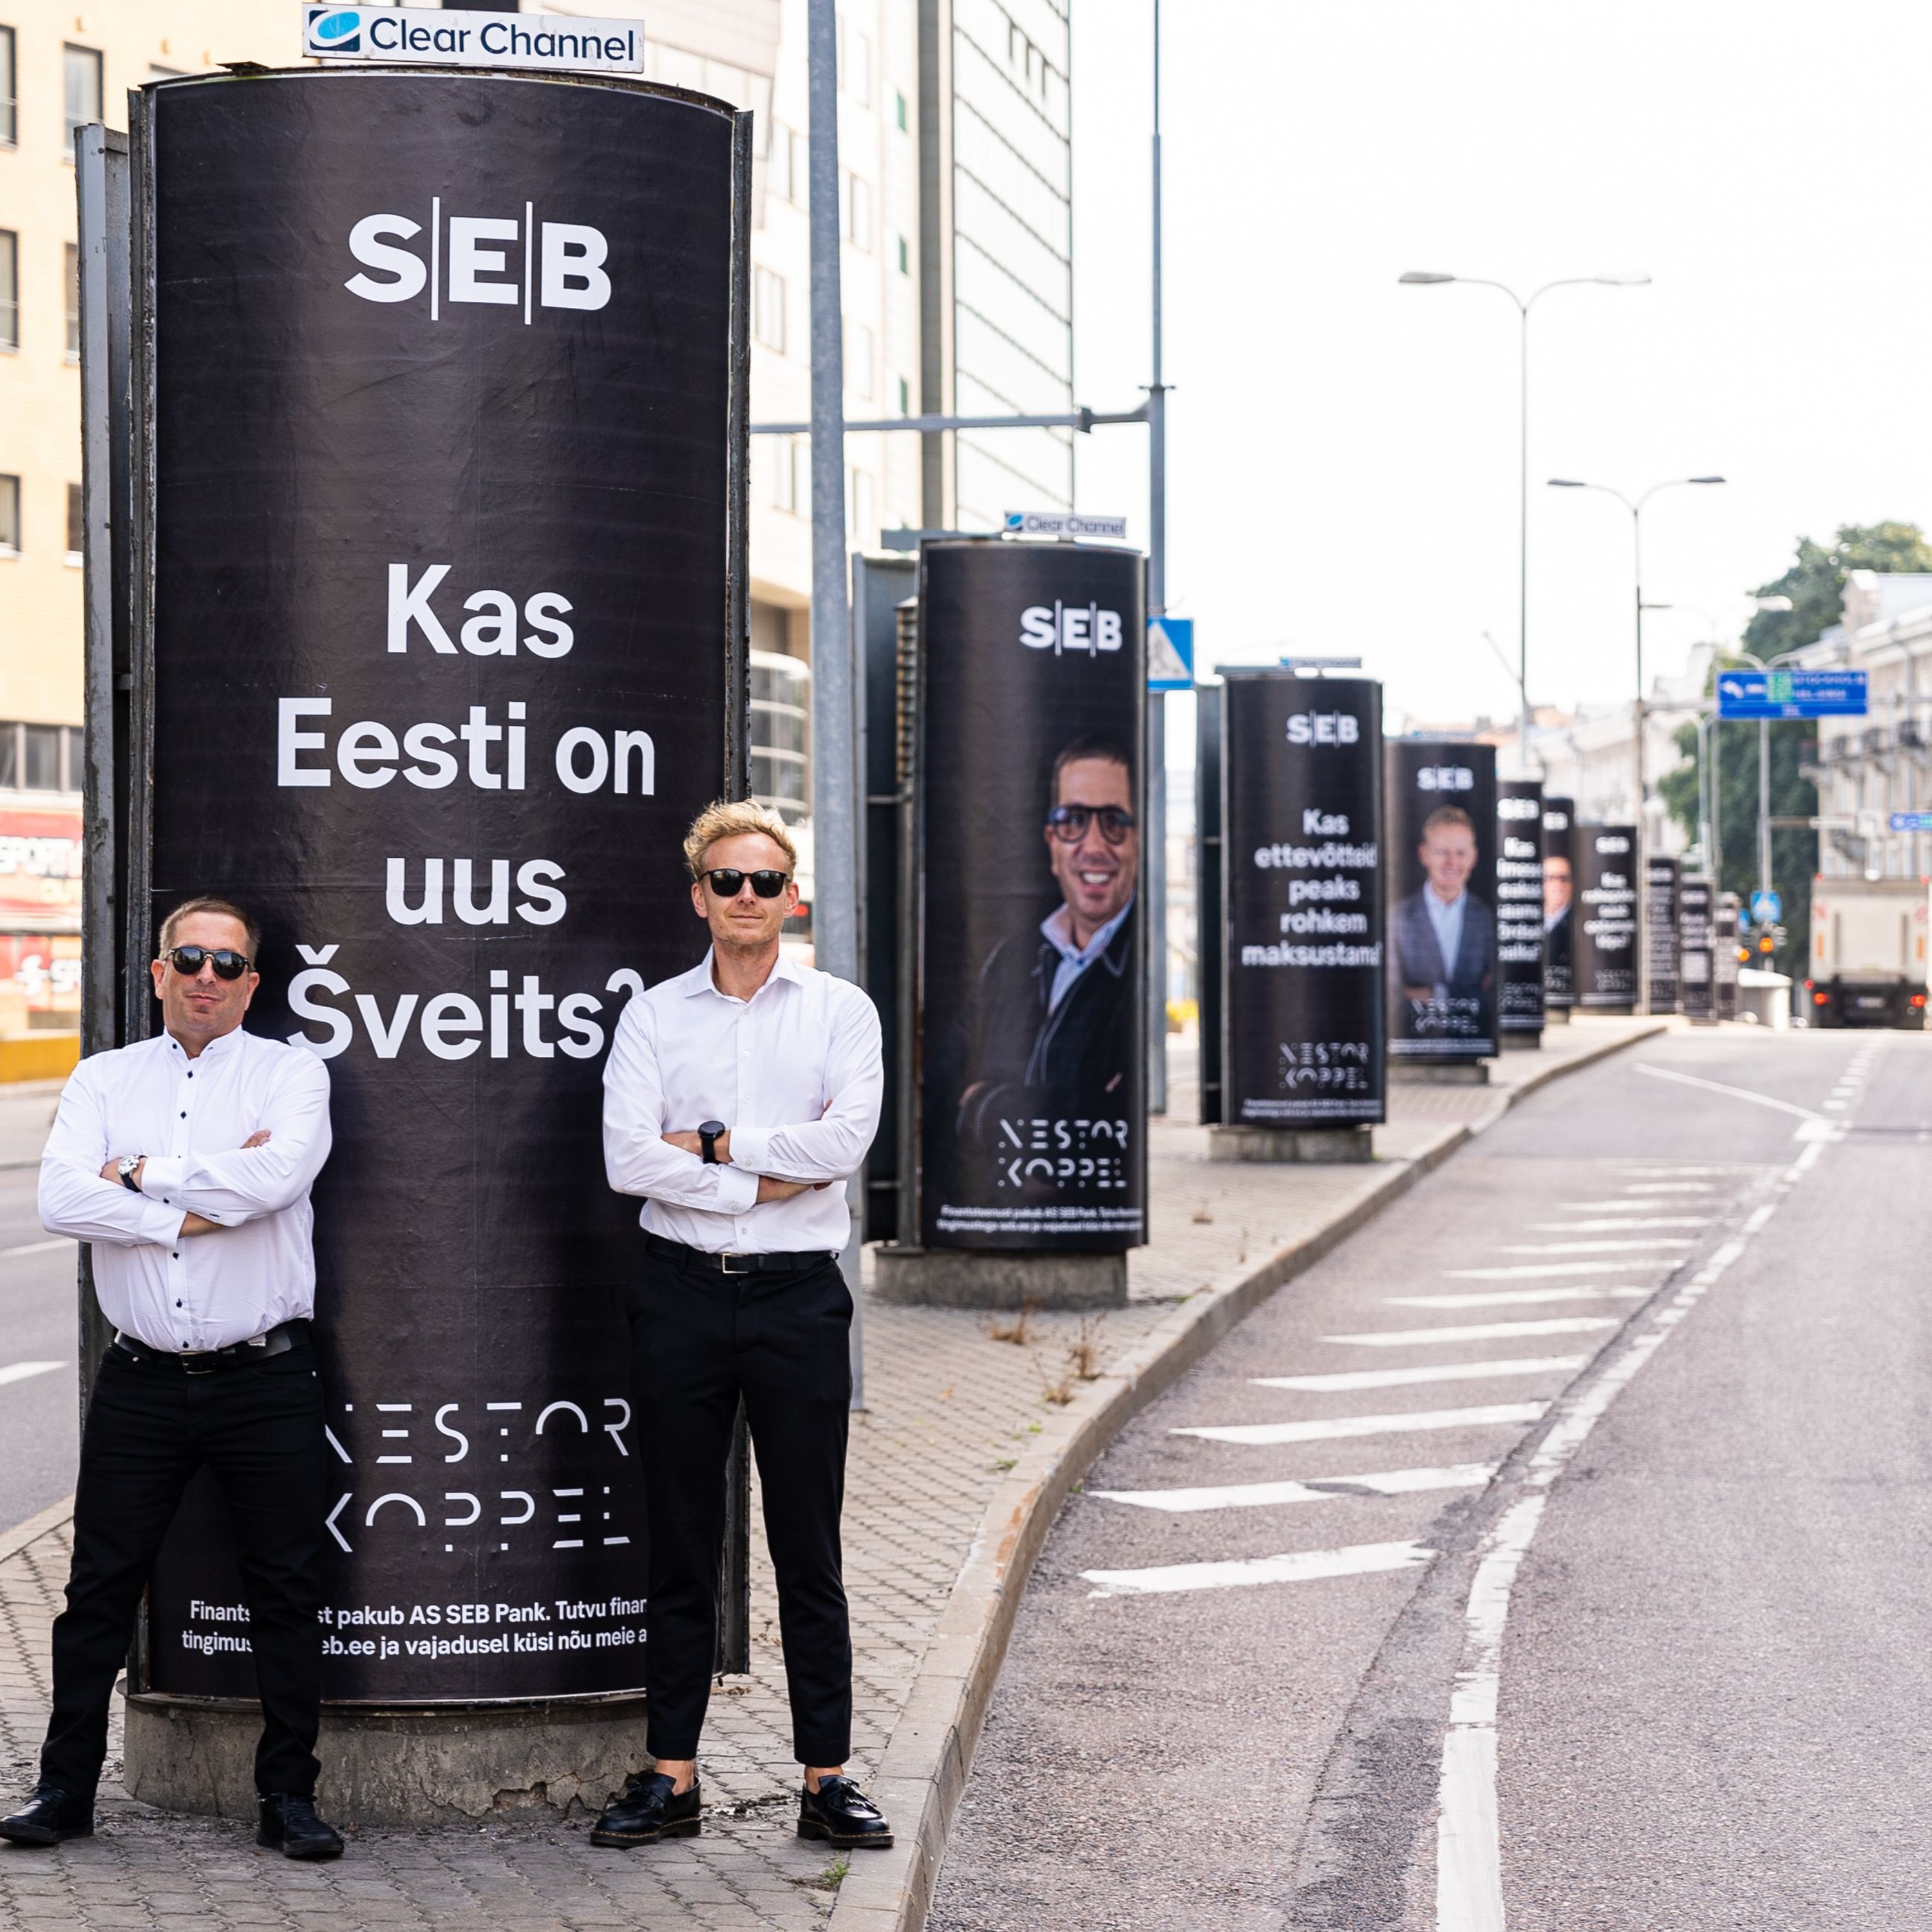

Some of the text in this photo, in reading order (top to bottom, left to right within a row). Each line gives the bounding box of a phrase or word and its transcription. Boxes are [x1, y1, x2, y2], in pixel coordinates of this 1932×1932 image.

[368, 17, 634, 62] Clear Channel
[387, 564, 574, 659] Kas
[278, 697, 656, 795] Eesti on
[1303, 808, 1350, 835] Kas
[386, 857, 567, 925] uus
[1289, 875, 1361, 906] peaks
[338, 1605, 405, 1629] pakub
[408, 1605, 442, 1625] AS
[446, 1604, 490, 1625] SEB
[495, 1602, 551, 1623] Pank.
[554, 1600, 606, 1620] Tutvu
[322, 1635, 376, 1655] eb.ee
[379, 1635, 400, 1660] ja
[405, 1633, 509, 1660] vajadusel
[513, 1631, 553, 1653] küsi
[558, 1630, 591, 1650] nõu
[596, 1625, 636, 1647] meie
